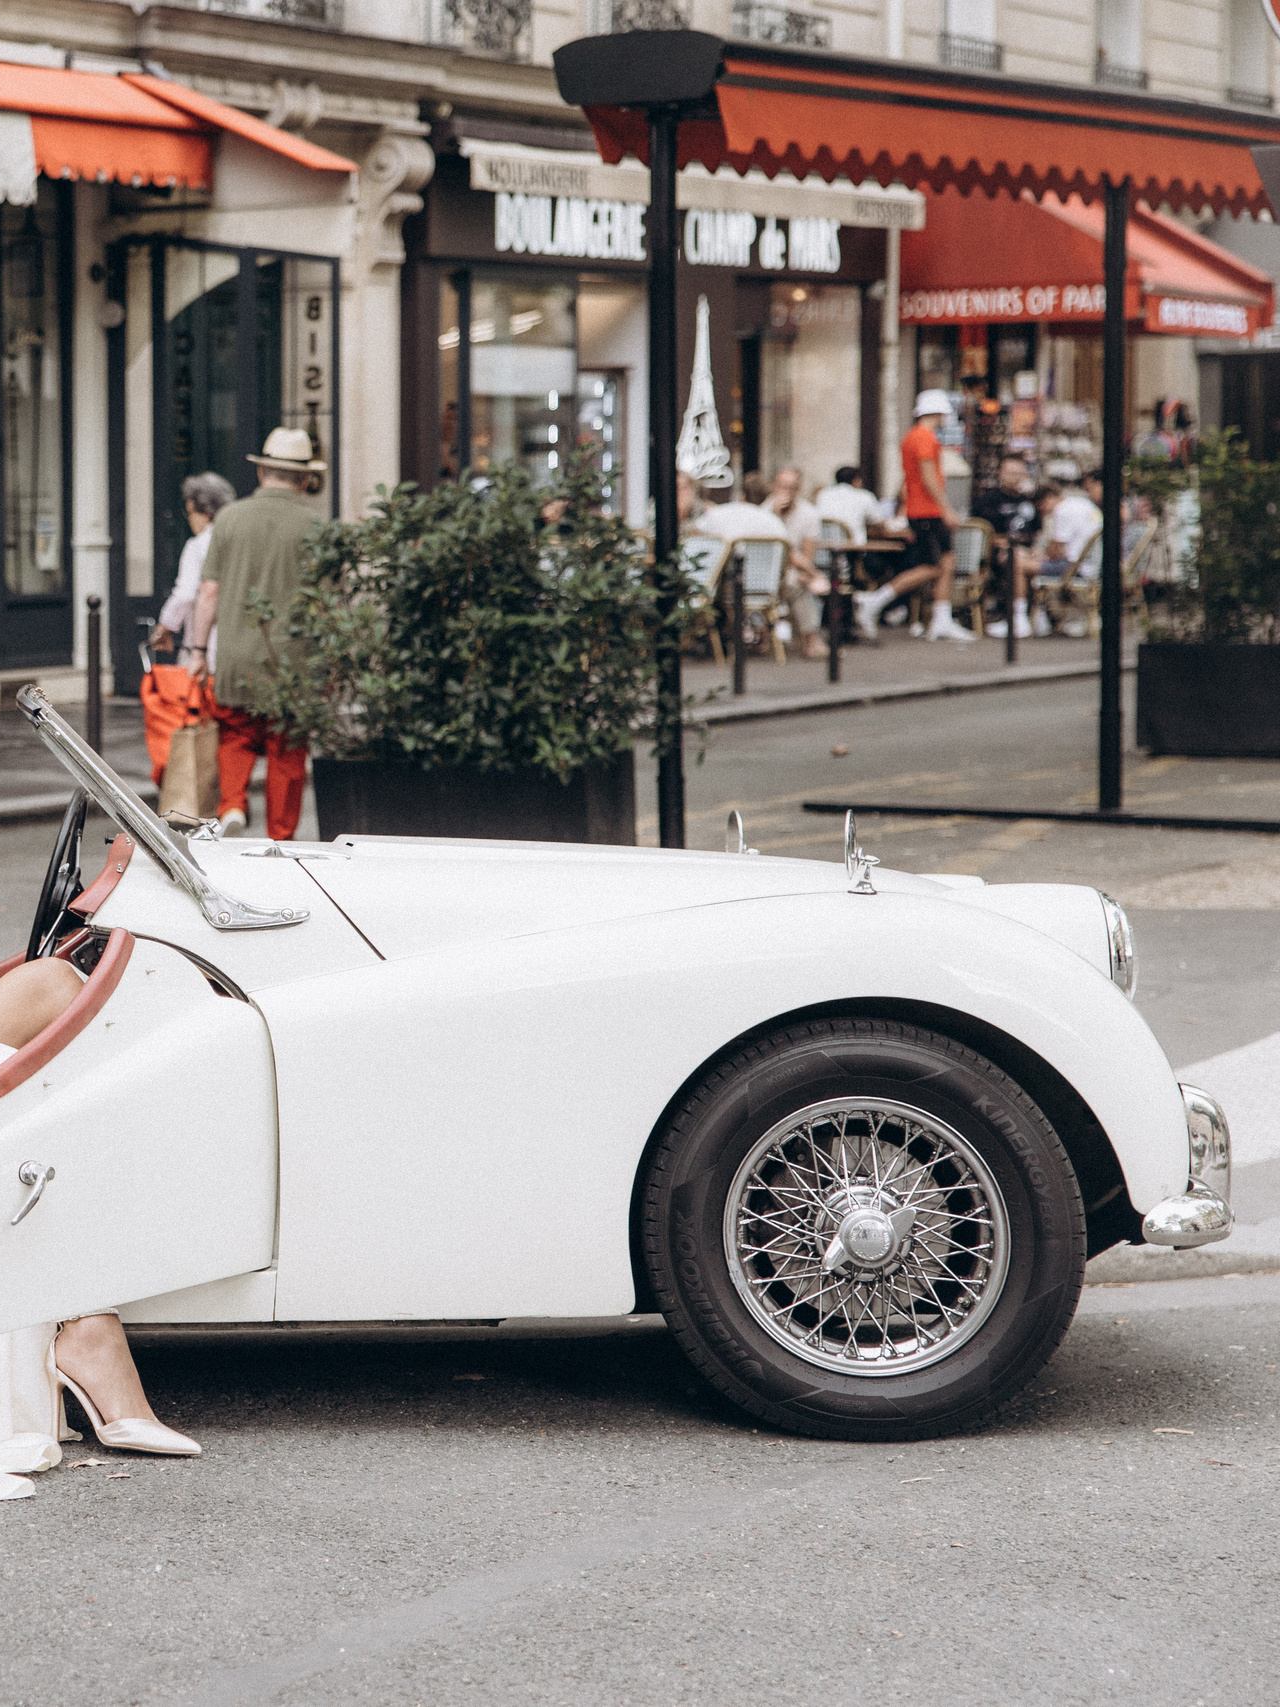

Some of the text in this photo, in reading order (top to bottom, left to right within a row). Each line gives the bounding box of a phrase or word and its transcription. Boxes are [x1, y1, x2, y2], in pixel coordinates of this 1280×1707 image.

[495, 191, 648, 261] BOULANGERIE
[684, 208, 757, 268] CHAMP
[788, 218, 842, 274] MARS
[901, 283, 1108, 320] SOUVENIRS OF PAR
